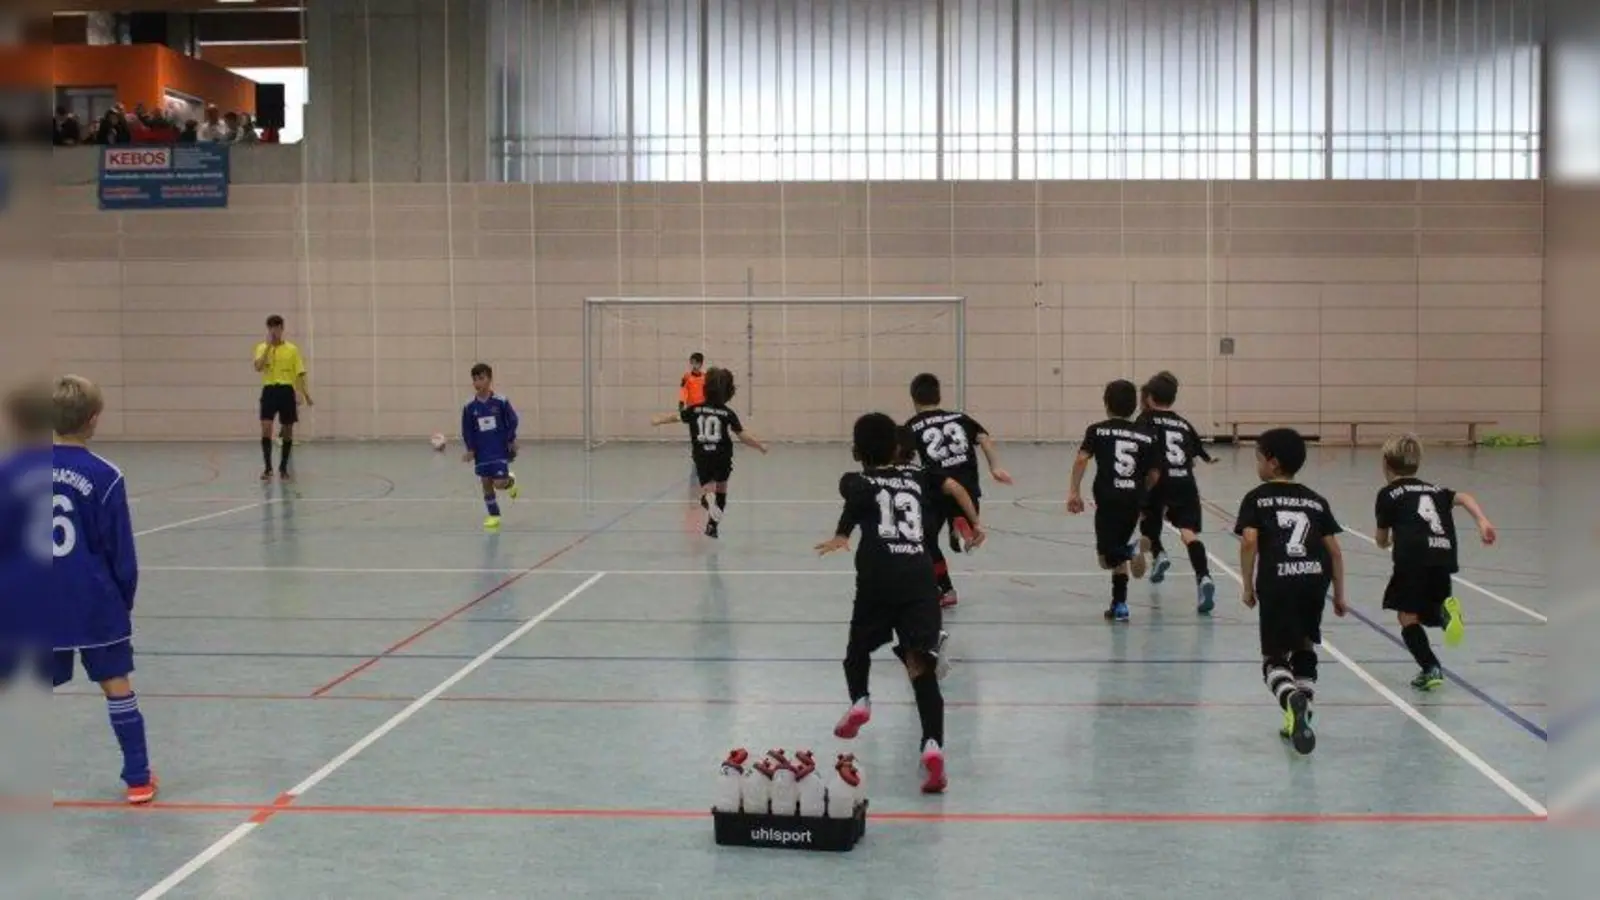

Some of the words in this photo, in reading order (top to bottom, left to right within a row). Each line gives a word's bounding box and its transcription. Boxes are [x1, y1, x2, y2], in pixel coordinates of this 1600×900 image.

[109, 152, 165, 166] KEBOS
[697, 415, 721, 442] 10
[922, 422, 968, 461] 23
[1114, 440, 1138, 477] 5
[1165, 430, 1186, 466] 5
[53, 494, 76, 557] 6
[876, 488, 924, 542] 13
[1417, 494, 1445, 535] 4
[1276, 511, 1310, 557] 7
[750, 828, 812, 845] uhlsport
